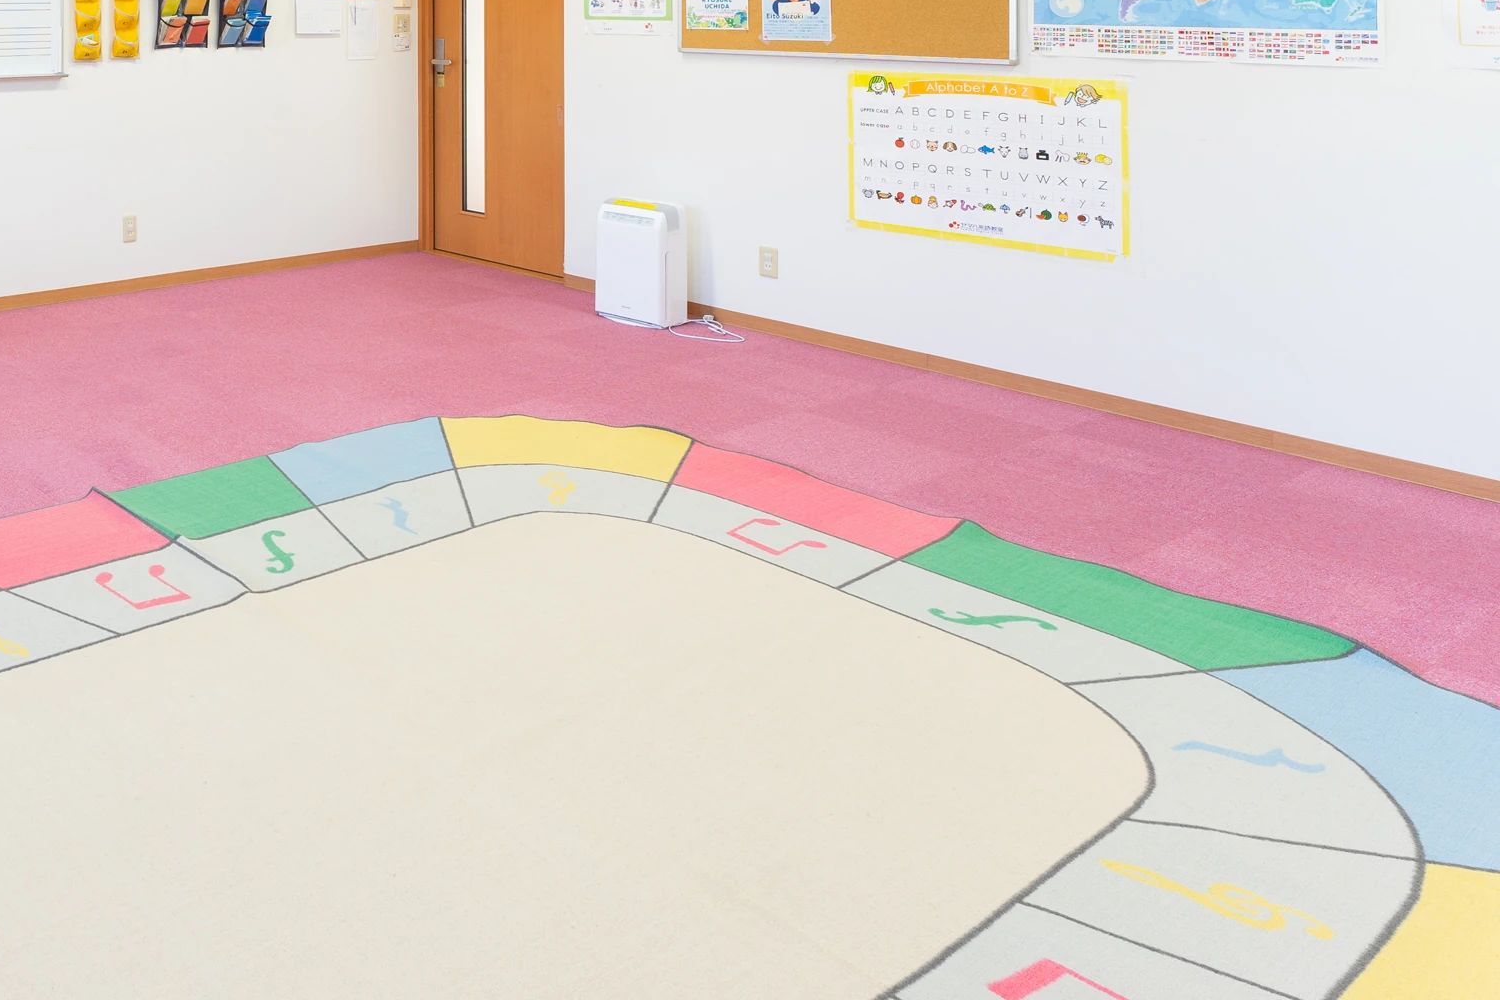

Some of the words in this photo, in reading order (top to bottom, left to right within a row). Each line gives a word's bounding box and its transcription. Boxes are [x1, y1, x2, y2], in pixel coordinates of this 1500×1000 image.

[926, 82, 985, 94] Alphabet
[990, 83, 999, 93] A
[1004, 84, 1017, 95] to
[1020, 86, 1029, 96] Z
[895, 106, 904, 115] A
[912, 107, 919, 116] B
[927, 108, 937, 117] C
[946, 109, 954, 118] D
[963, 110, 971, 119] E
[982, 112, 990, 120] F
[998, 112, 1009, 122] G
[1019, 113, 1027, 123] H
[1058, 117, 1065, 126] J
[1077, 118, 1087, 127] K
[1098, 119, 1107, 128] L
[863, 158, 873, 167] M
[880, 160, 888, 168] N
[895, 161, 904, 170] O
[912, 162, 920, 171] P
[927, 164, 937, 173] Q
[946, 166, 954, 175] R
[964, 167, 971, 176] S
[982, 169, 992, 178] T
[1000, 171, 1009, 180] U
[1019, 172, 1028, 182] V
[1036, 174, 1050, 184] W
[1058, 177, 1068, 186] X
[1079, 179, 1087, 188] Y
[1098, 180, 1108, 190] Z
